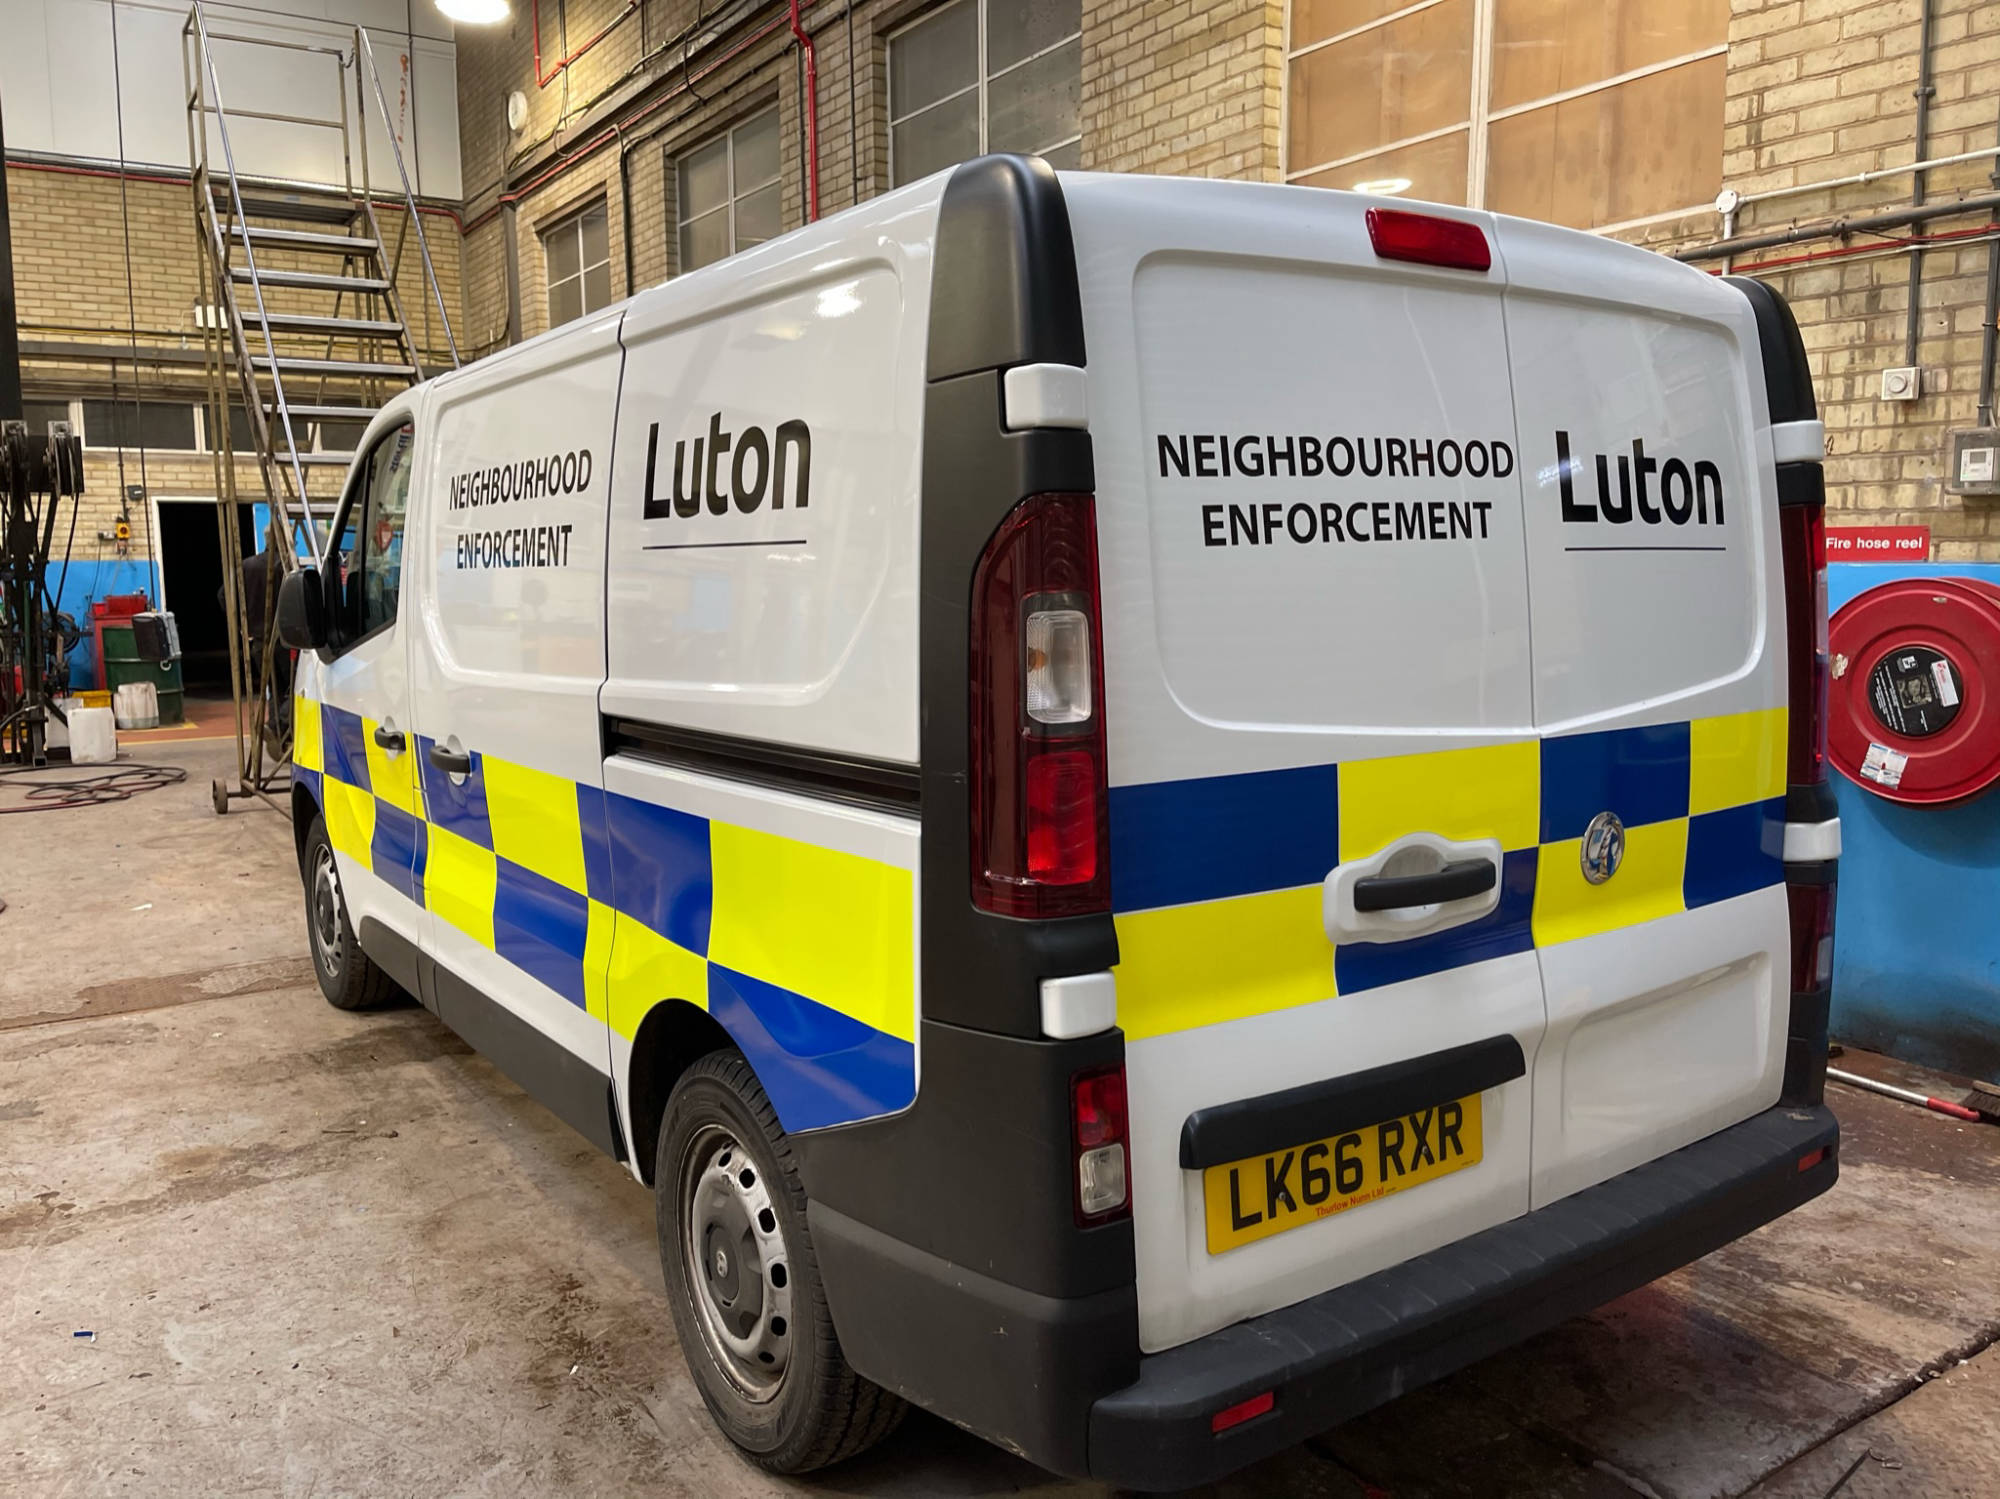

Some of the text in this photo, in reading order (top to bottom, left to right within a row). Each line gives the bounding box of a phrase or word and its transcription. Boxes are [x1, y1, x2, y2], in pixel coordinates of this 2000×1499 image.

[643, 411, 811, 520] Luton
[1157, 434, 1514, 479] NEIGHBOURHOOD
[1555, 431, 1725, 526] Luton
[449, 449, 593, 511] NEIGHBOURHOOD
[456, 524, 573, 569] ENFORCEMENT
[1202, 501, 1492, 547] ENFORCEMENT
[1825, 536, 1923, 549] Fire hose reel
[1230, 1101, 1463, 1232] LK66 RXR
[1315, 1198, 1349, 1217] Thurlow
[1372, 1186, 1385, 1199] Ltd
